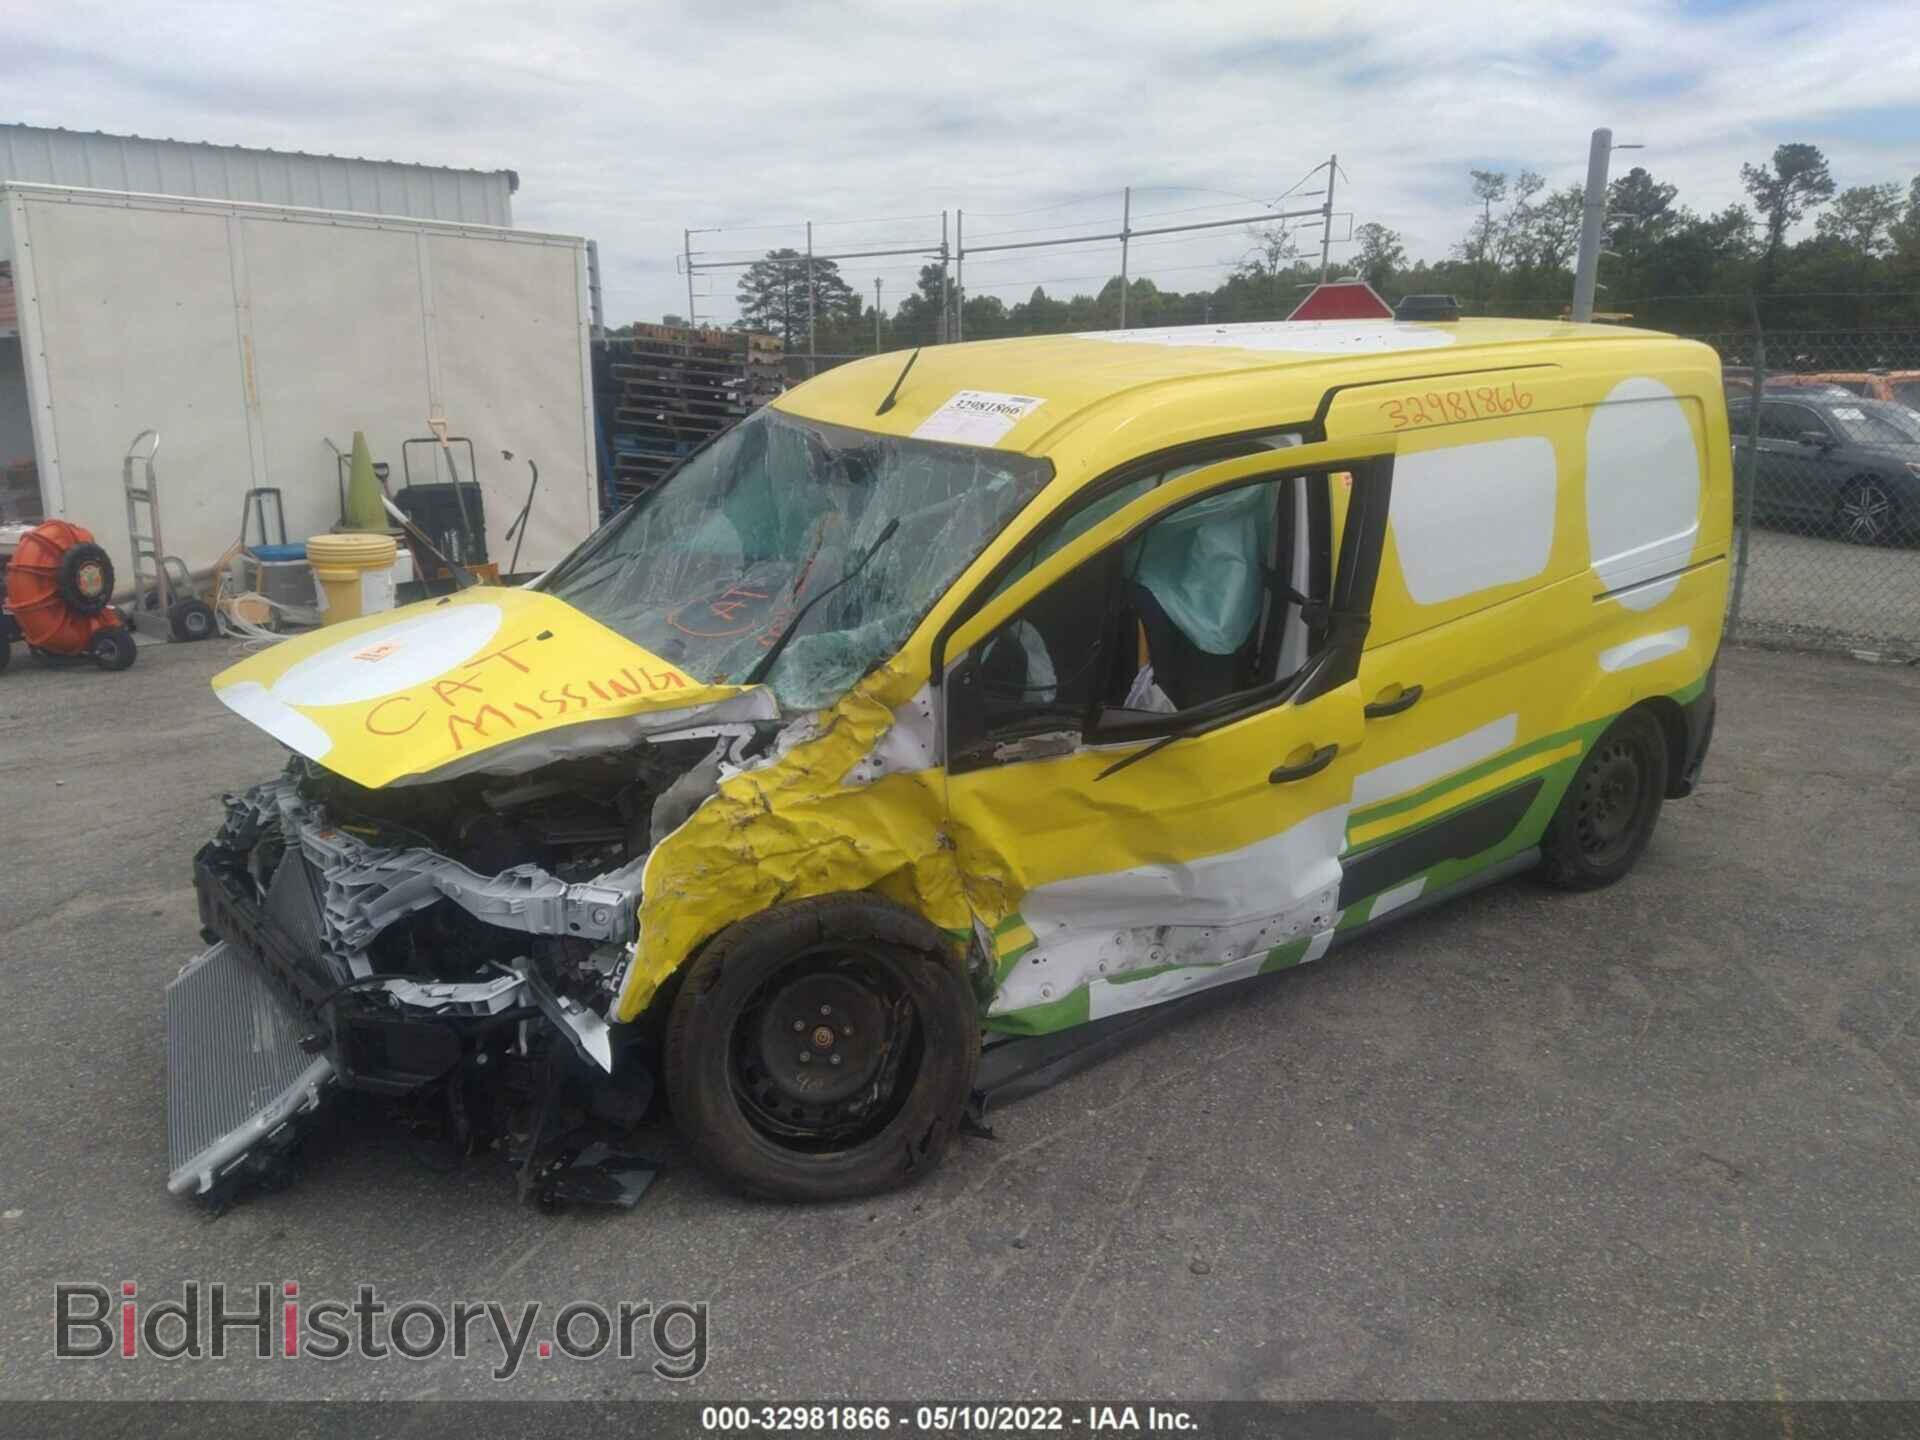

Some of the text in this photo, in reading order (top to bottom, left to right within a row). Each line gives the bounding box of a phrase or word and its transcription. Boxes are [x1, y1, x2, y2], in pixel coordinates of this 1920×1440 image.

[1379, 382, 1534, 427] 32981866
[365, 638, 531, 736] CAT
[446, 666, 688, 751] MISSING
